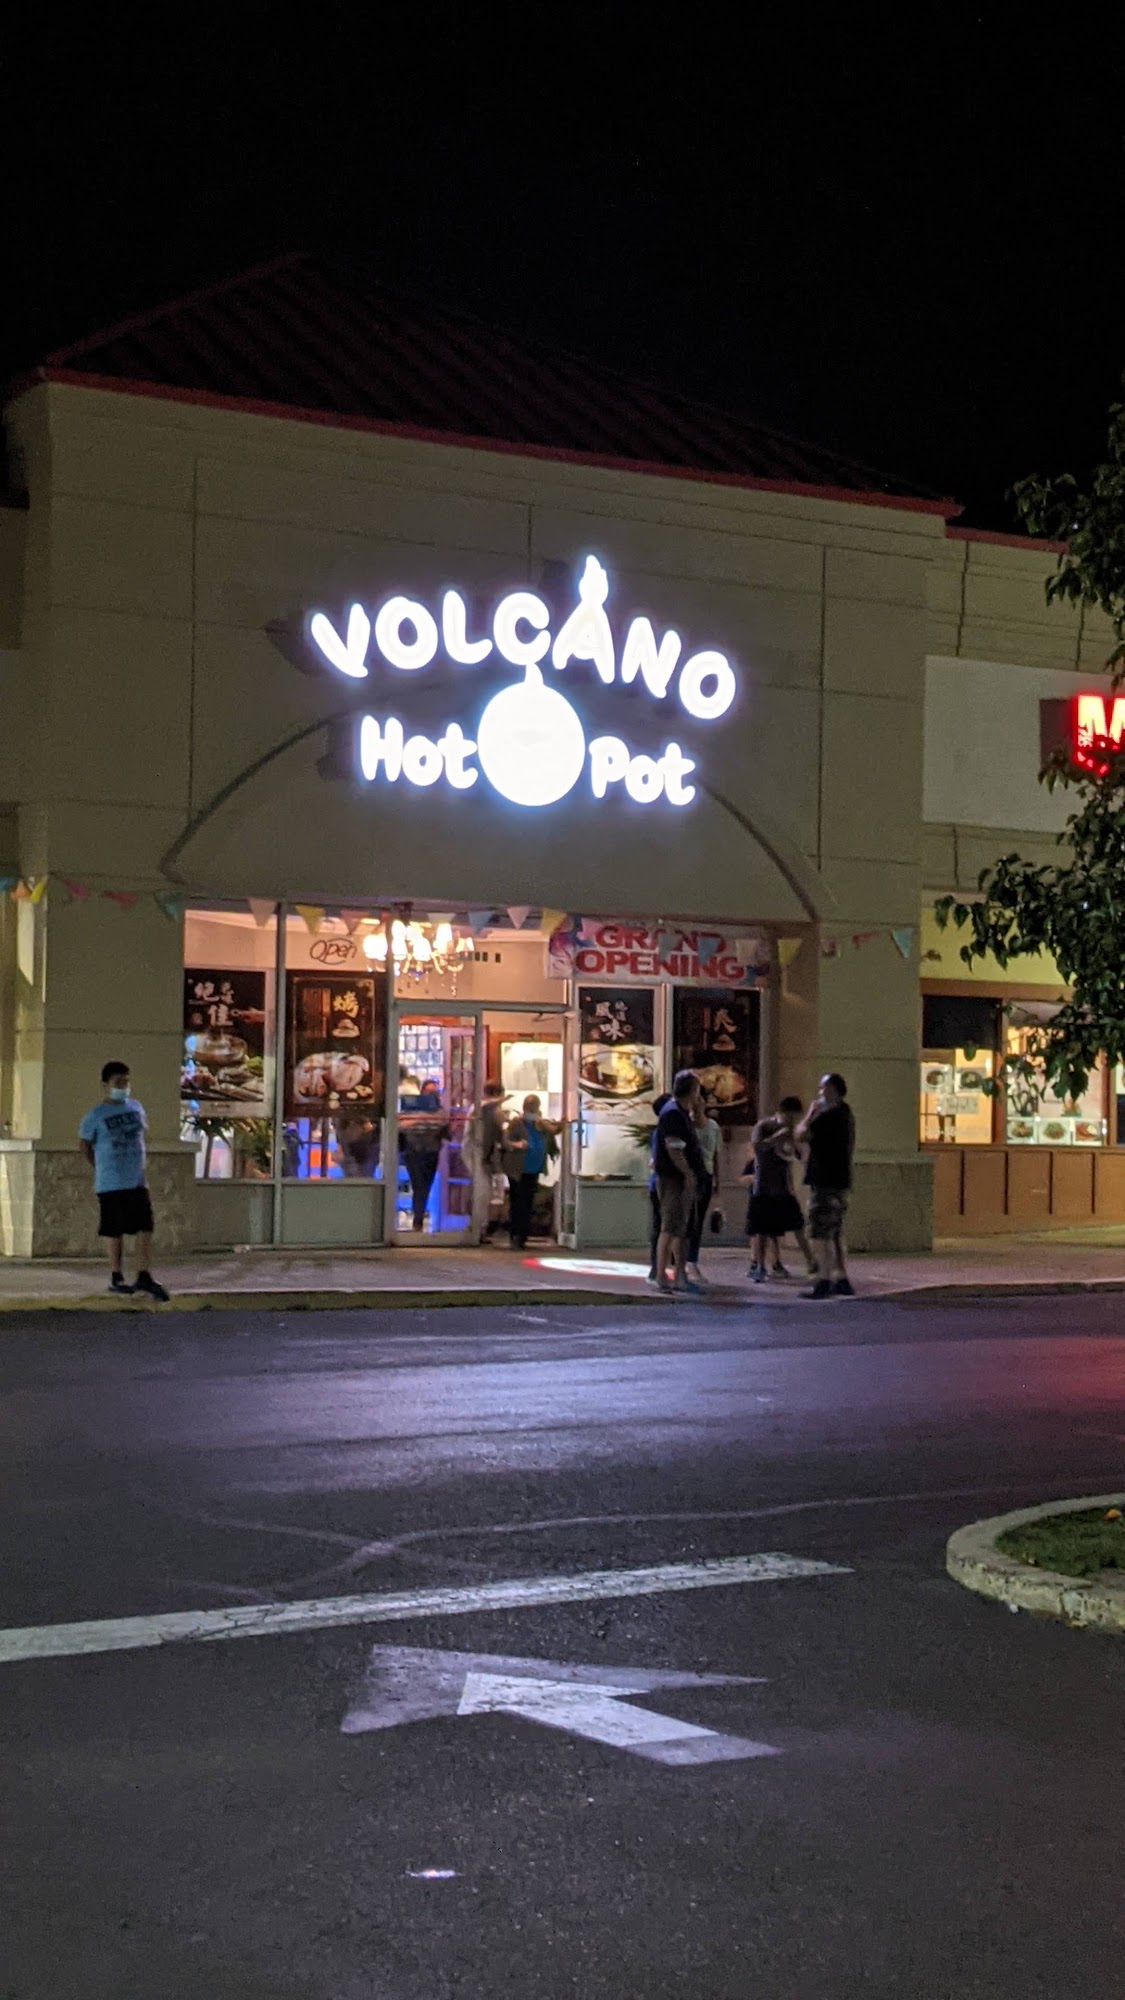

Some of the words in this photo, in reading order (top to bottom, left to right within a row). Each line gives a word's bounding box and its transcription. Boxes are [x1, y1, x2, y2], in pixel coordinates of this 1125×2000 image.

[311, 557, 737, 719] VOLCANO
[361, 714, 479, 790] Hot
[588, 736, 697, 806] Pot
[575, 949, 746, 980] OPENING
